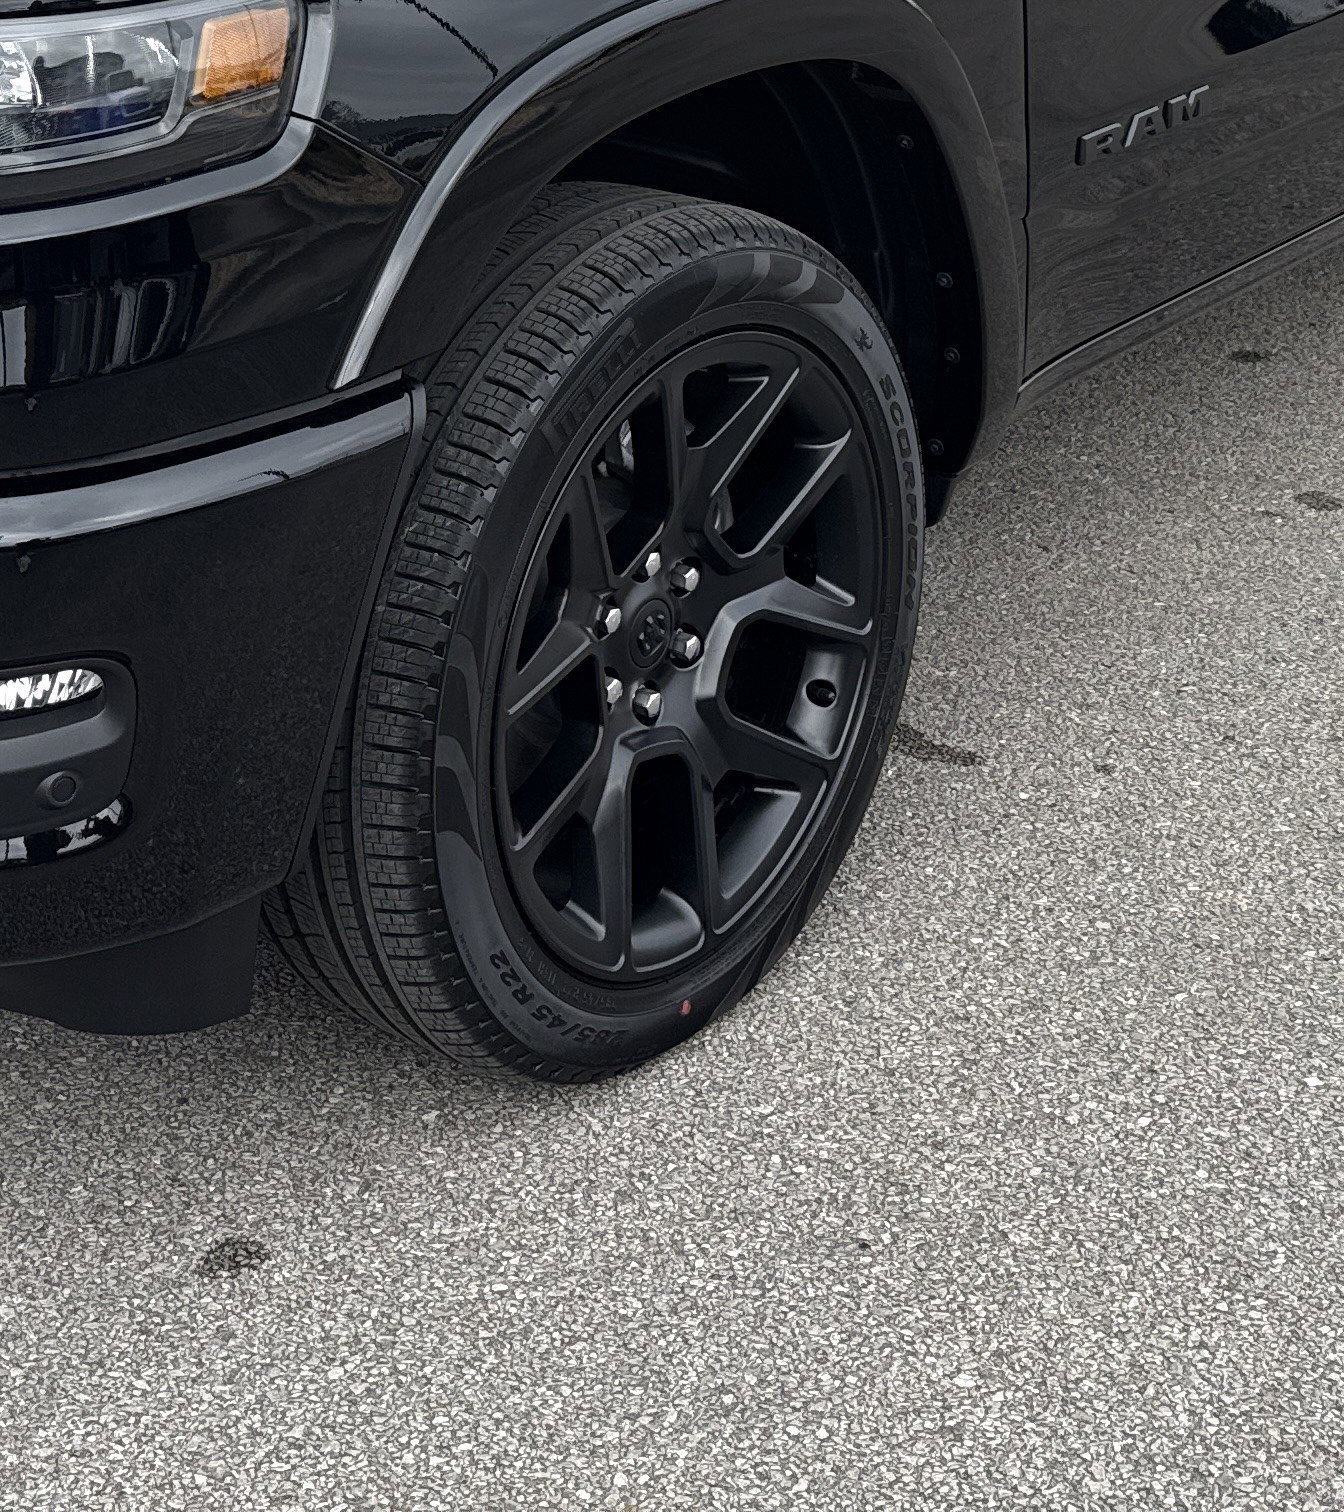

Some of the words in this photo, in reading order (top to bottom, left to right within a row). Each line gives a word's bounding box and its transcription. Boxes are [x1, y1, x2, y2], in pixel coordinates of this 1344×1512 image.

[1074, 84, 1210, 167] RAM
[878, 373, 919, 611] SCORPION
[489, 948, 535, 1006] R22
